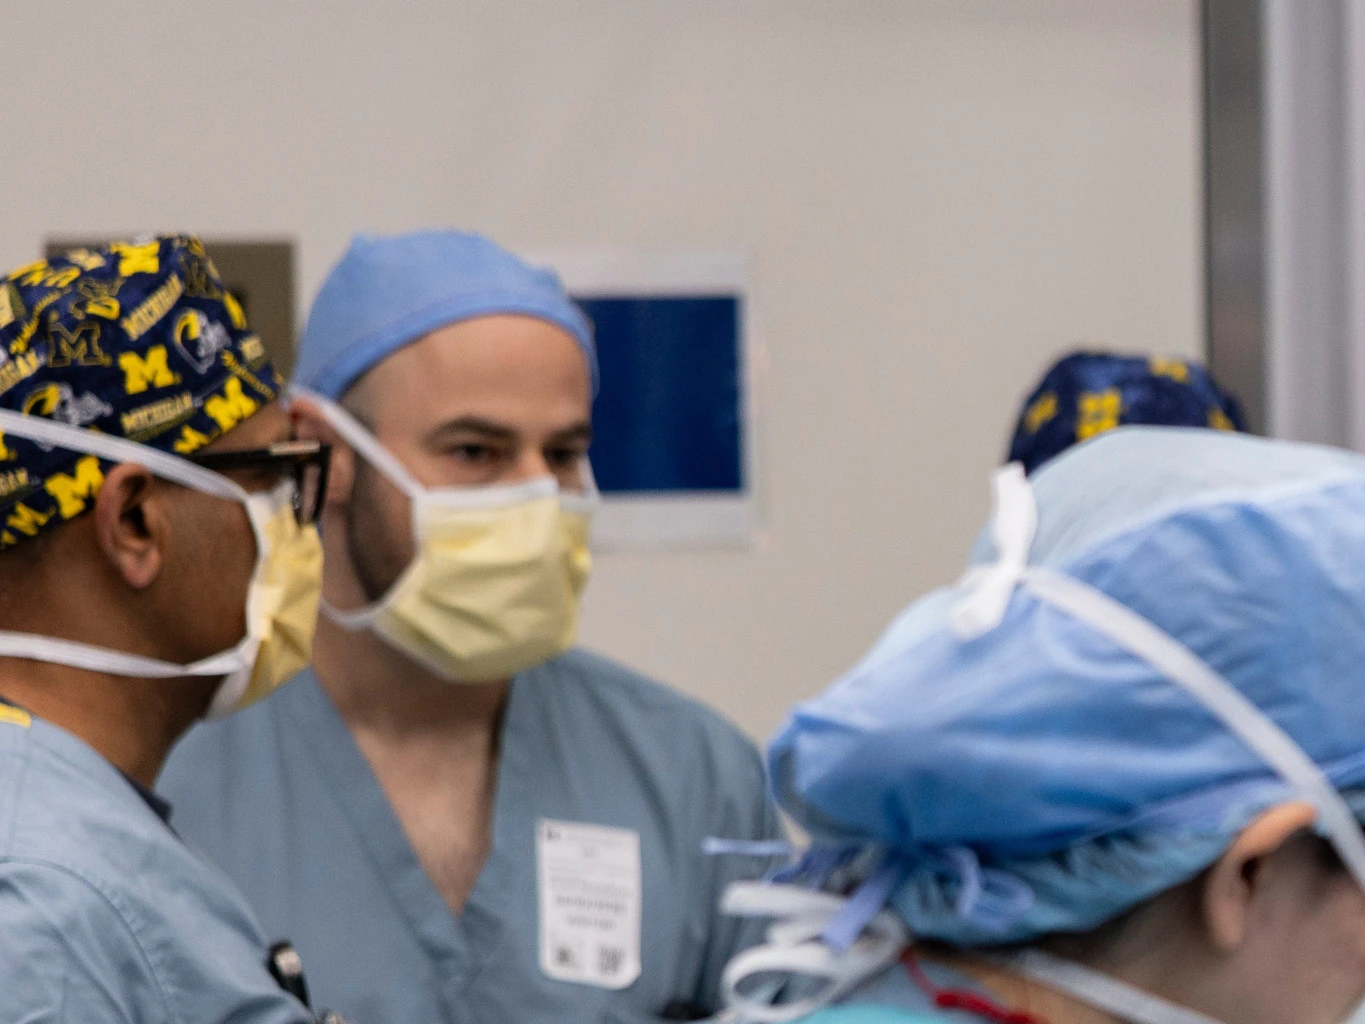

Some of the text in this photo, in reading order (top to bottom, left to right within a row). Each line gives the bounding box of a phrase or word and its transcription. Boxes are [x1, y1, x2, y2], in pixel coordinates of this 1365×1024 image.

[121, 273, 184, 342] MICHIGAN
[118, 344, 175, 395] M
[121, 390, 193, 434] MICHIGAN
[203, 376, 257, 433] M
[45, 454, 104, 519] M
